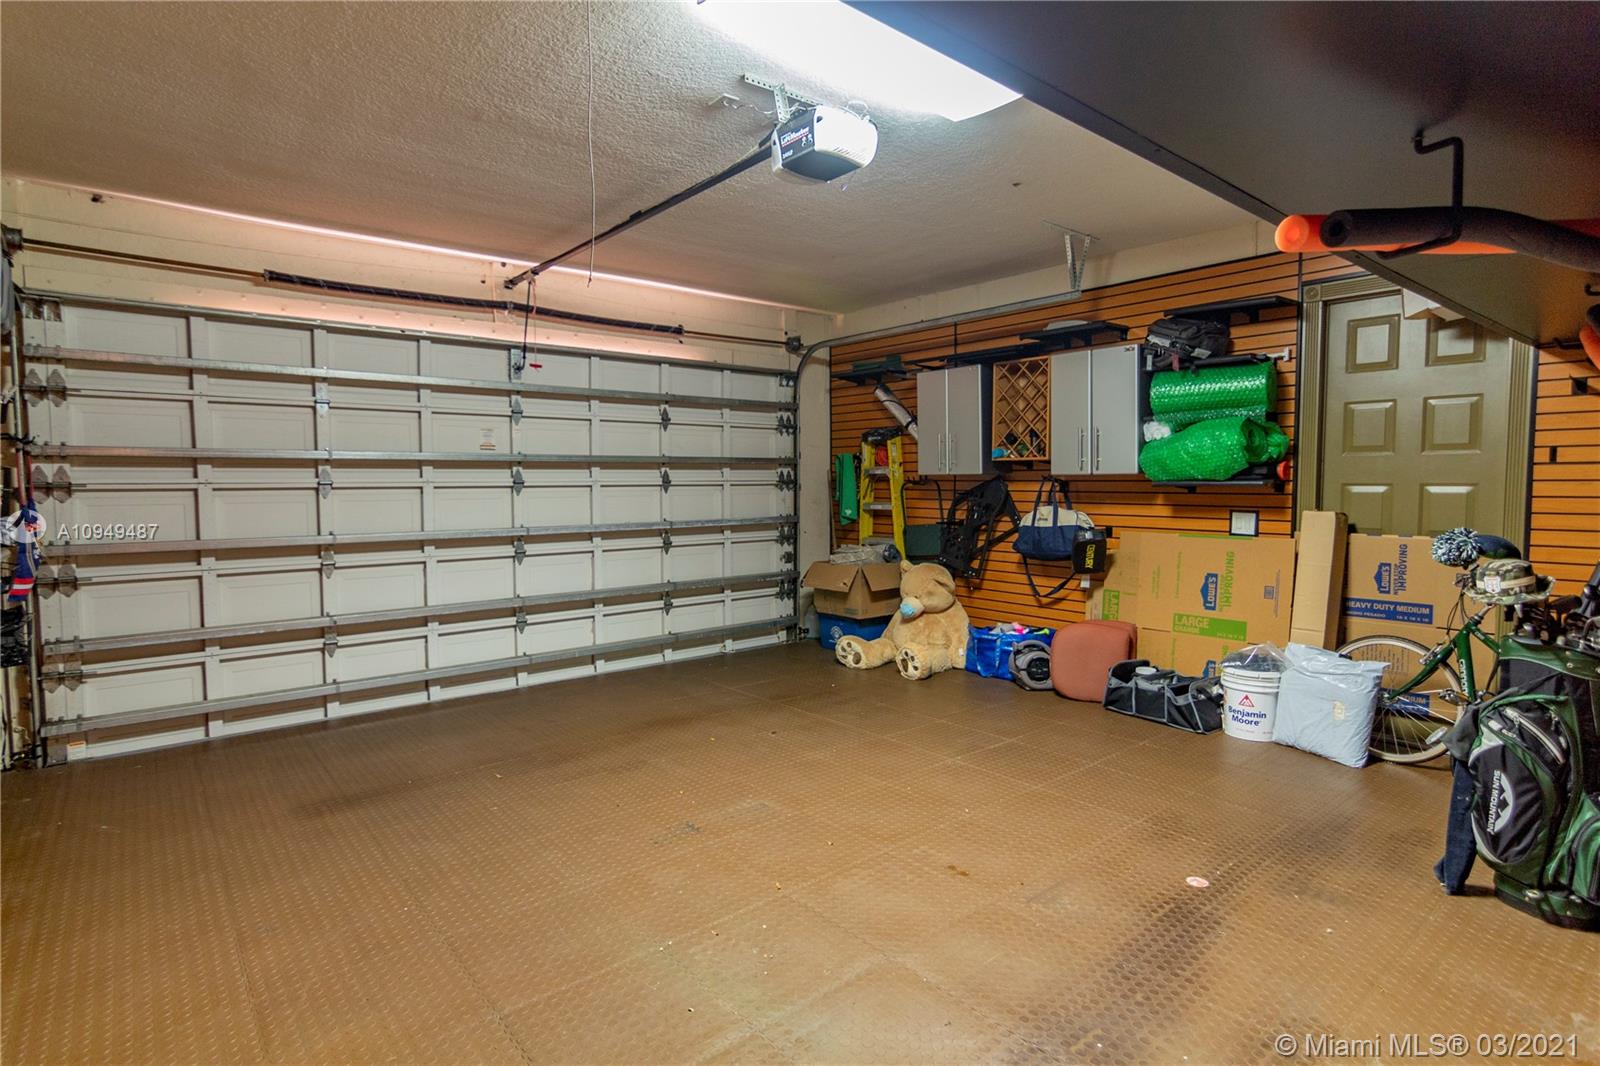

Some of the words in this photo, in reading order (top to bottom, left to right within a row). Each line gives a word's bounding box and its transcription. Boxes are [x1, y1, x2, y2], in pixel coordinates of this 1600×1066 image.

[1223, 551, 1236, 608] IMPROVING
[1399, 544, 1408, 591] IMPROVING
[1206, 576, 1217, 608] LOWE'S
[1373, 602, 1395, 611] DUTY
[1396, 604, 1430, 614] MEDIUM
[1175, 615, 1210, 629] LARGE
[1458, 659, 1469, 696] cannon
[1228, 705, 1267, 720] Benjamin
[1232, 715, 1260, 727] Moore
[1492, 770, 1501, 787] SUN
[1486, 787, 1499, 835] MOUNTAIN
